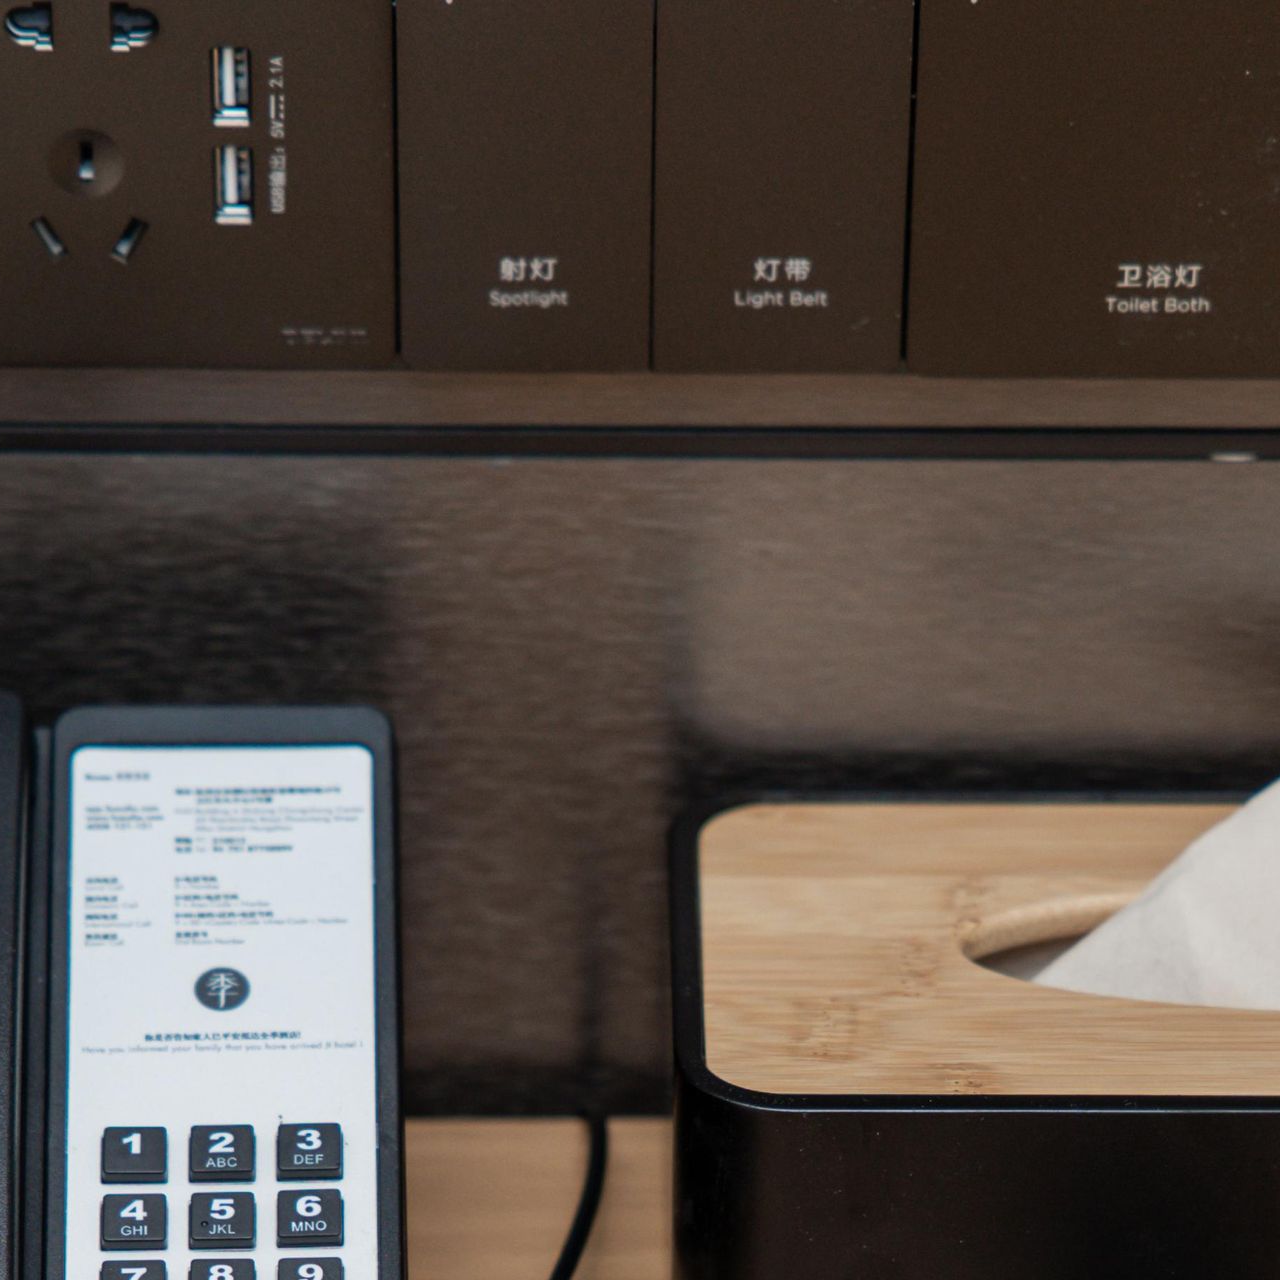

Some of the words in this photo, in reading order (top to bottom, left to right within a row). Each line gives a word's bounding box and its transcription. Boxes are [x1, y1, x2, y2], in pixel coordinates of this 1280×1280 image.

[500, 257, 557, 281] 射灯
[754, 258, 811, 282] 灯带
[1117, 264, 1202, 288] 卫浴灯
[489, 290, 568, 308] Spotlight
[734, 291, 784, 308] Light
[789, 291, 828, 306] Belt
[1106, 296, 1159, 313] Toilet
[1164, 297, 1210, 313] Both
[122, 1132, 142, 1155] 1
[208, 1132, 235, 1153] 2
[296, 1129, 322, 1150] 3
[205, 1156, 238, 1168] ABC
[293, 1153, 324, 1165] DEF
[119, 1199, 148, 1221] 4
[210, 1198, 236, 1220] 5
[296, 1195, 322, 1217] 6
[120, 1225, 148, 1237] GHI
[208, 1224, 236, 1235] JKL
[291, 1220, 327, 1232] MNO
